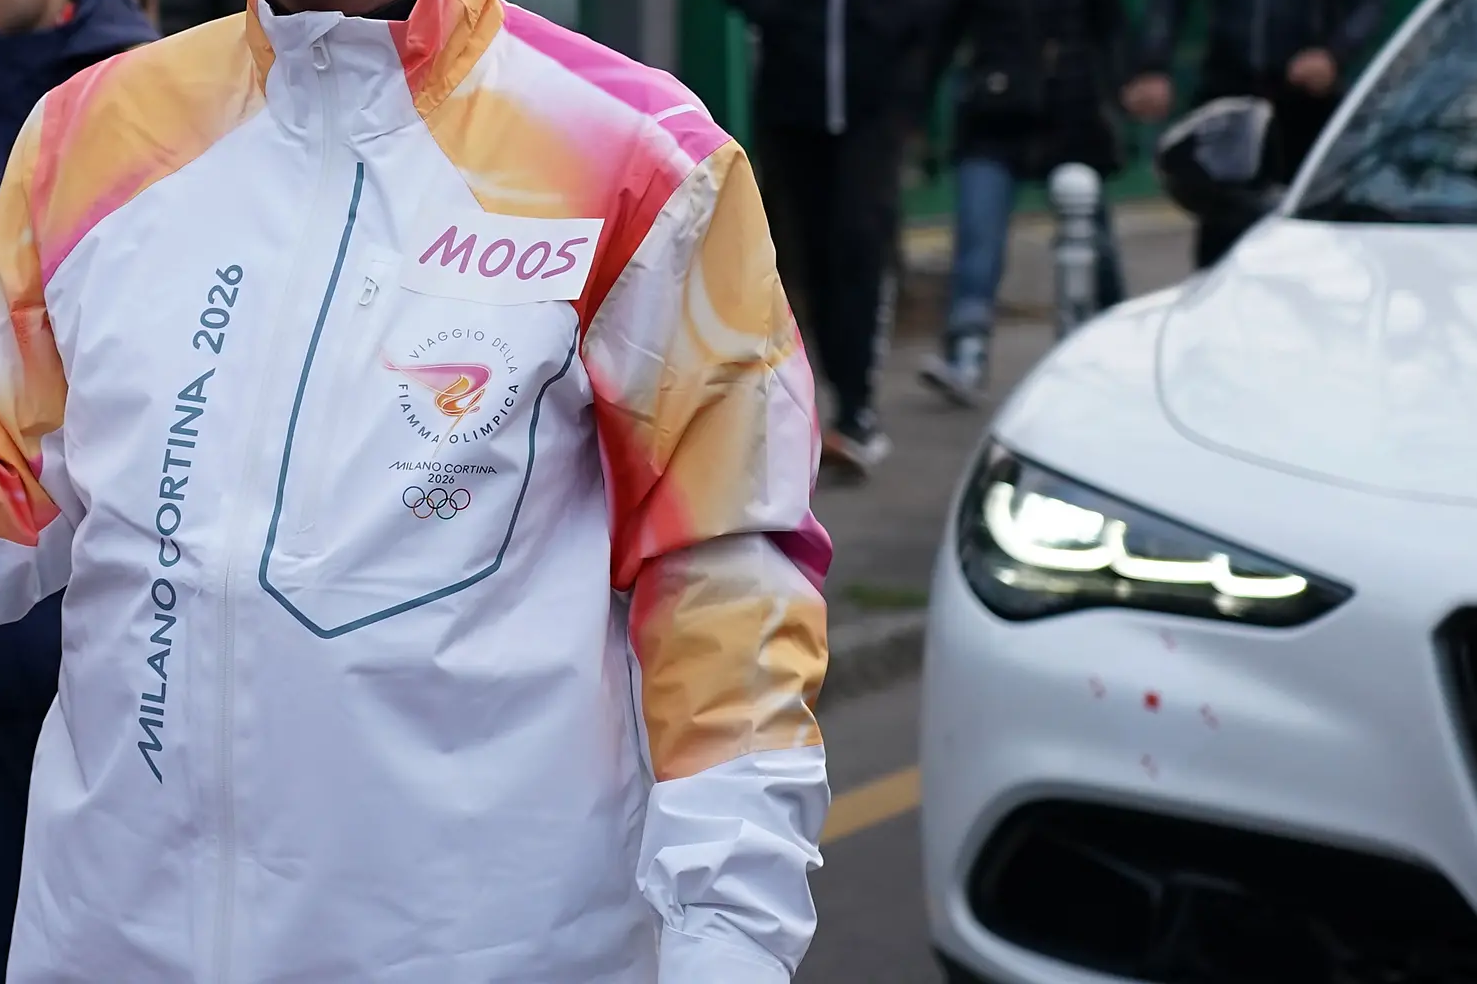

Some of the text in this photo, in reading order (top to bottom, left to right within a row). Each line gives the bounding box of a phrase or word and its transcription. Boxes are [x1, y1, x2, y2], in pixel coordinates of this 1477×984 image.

[408, 328, 518, 374] VIAGGIO DELLA
[398, 383, 520, 444] FIAMMA OLIMPICA
[388, 461, 498, 475] MILANO CORTINA
[427, 474, 455, 485] 2026
[137, 264, 244, 784] MILANO CORTINA 2026
